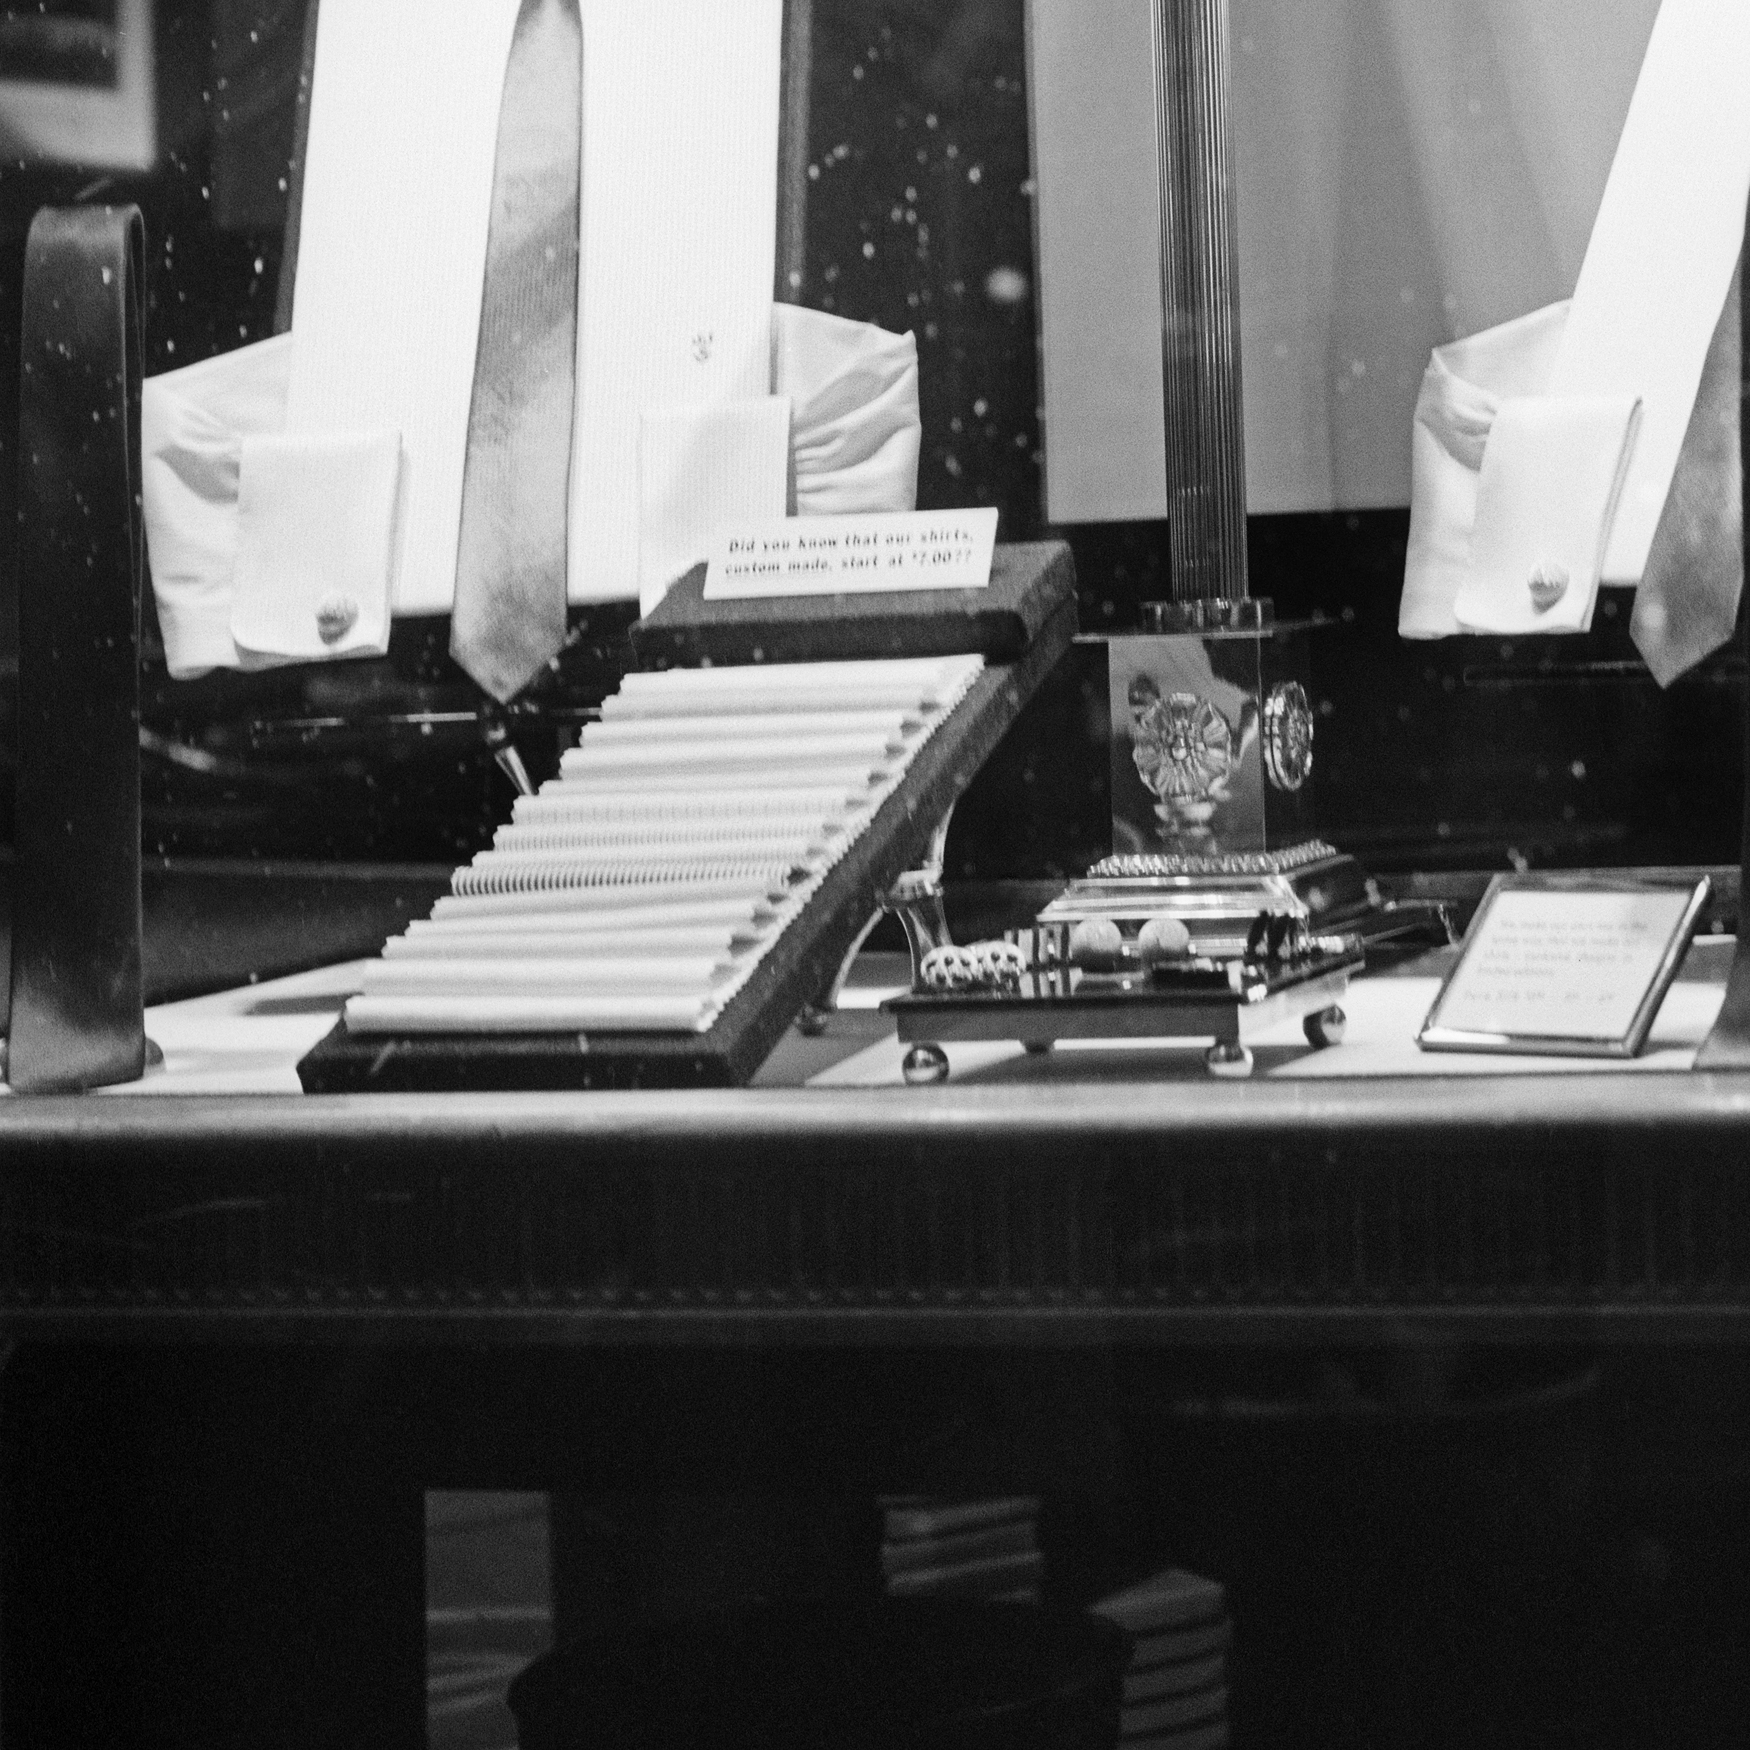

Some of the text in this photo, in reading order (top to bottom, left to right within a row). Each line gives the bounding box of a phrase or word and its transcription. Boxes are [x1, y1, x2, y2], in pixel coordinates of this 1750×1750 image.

[728, 536, 756, 553] Did
[761, 538, 791, 553] you
[797, 534, 839, 550] know
[843, 531, 878, 547] that
[884, 534, 911, 546] our
[724, 562, 781, 576] custom
[840, 555, 878, 569] start
[887, 552, 904, 567] at
